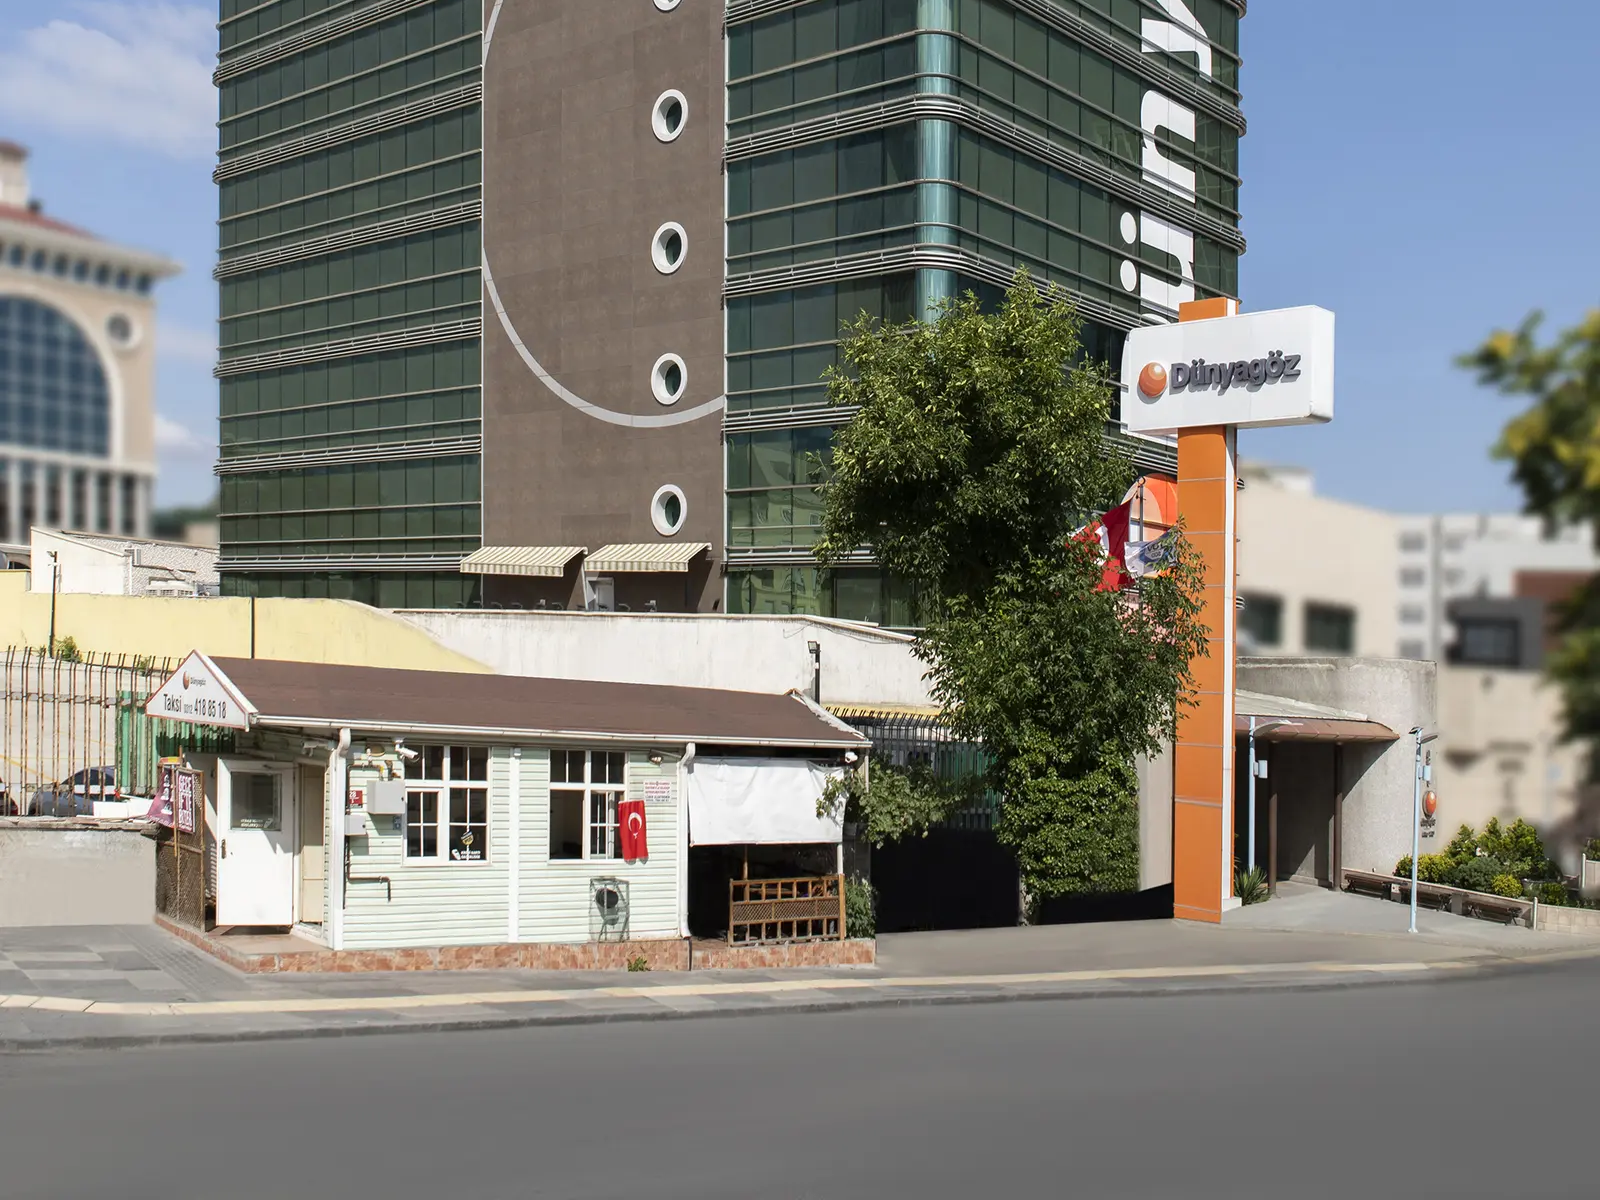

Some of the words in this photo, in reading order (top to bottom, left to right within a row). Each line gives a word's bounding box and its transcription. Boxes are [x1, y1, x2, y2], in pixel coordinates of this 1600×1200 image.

[1171, 350, 1301, 391] Dünyagöz
[163, 694, 182, 713] Taksi
[194, 698, 206, 716] 418
[218, 701, 227, 719] 18
